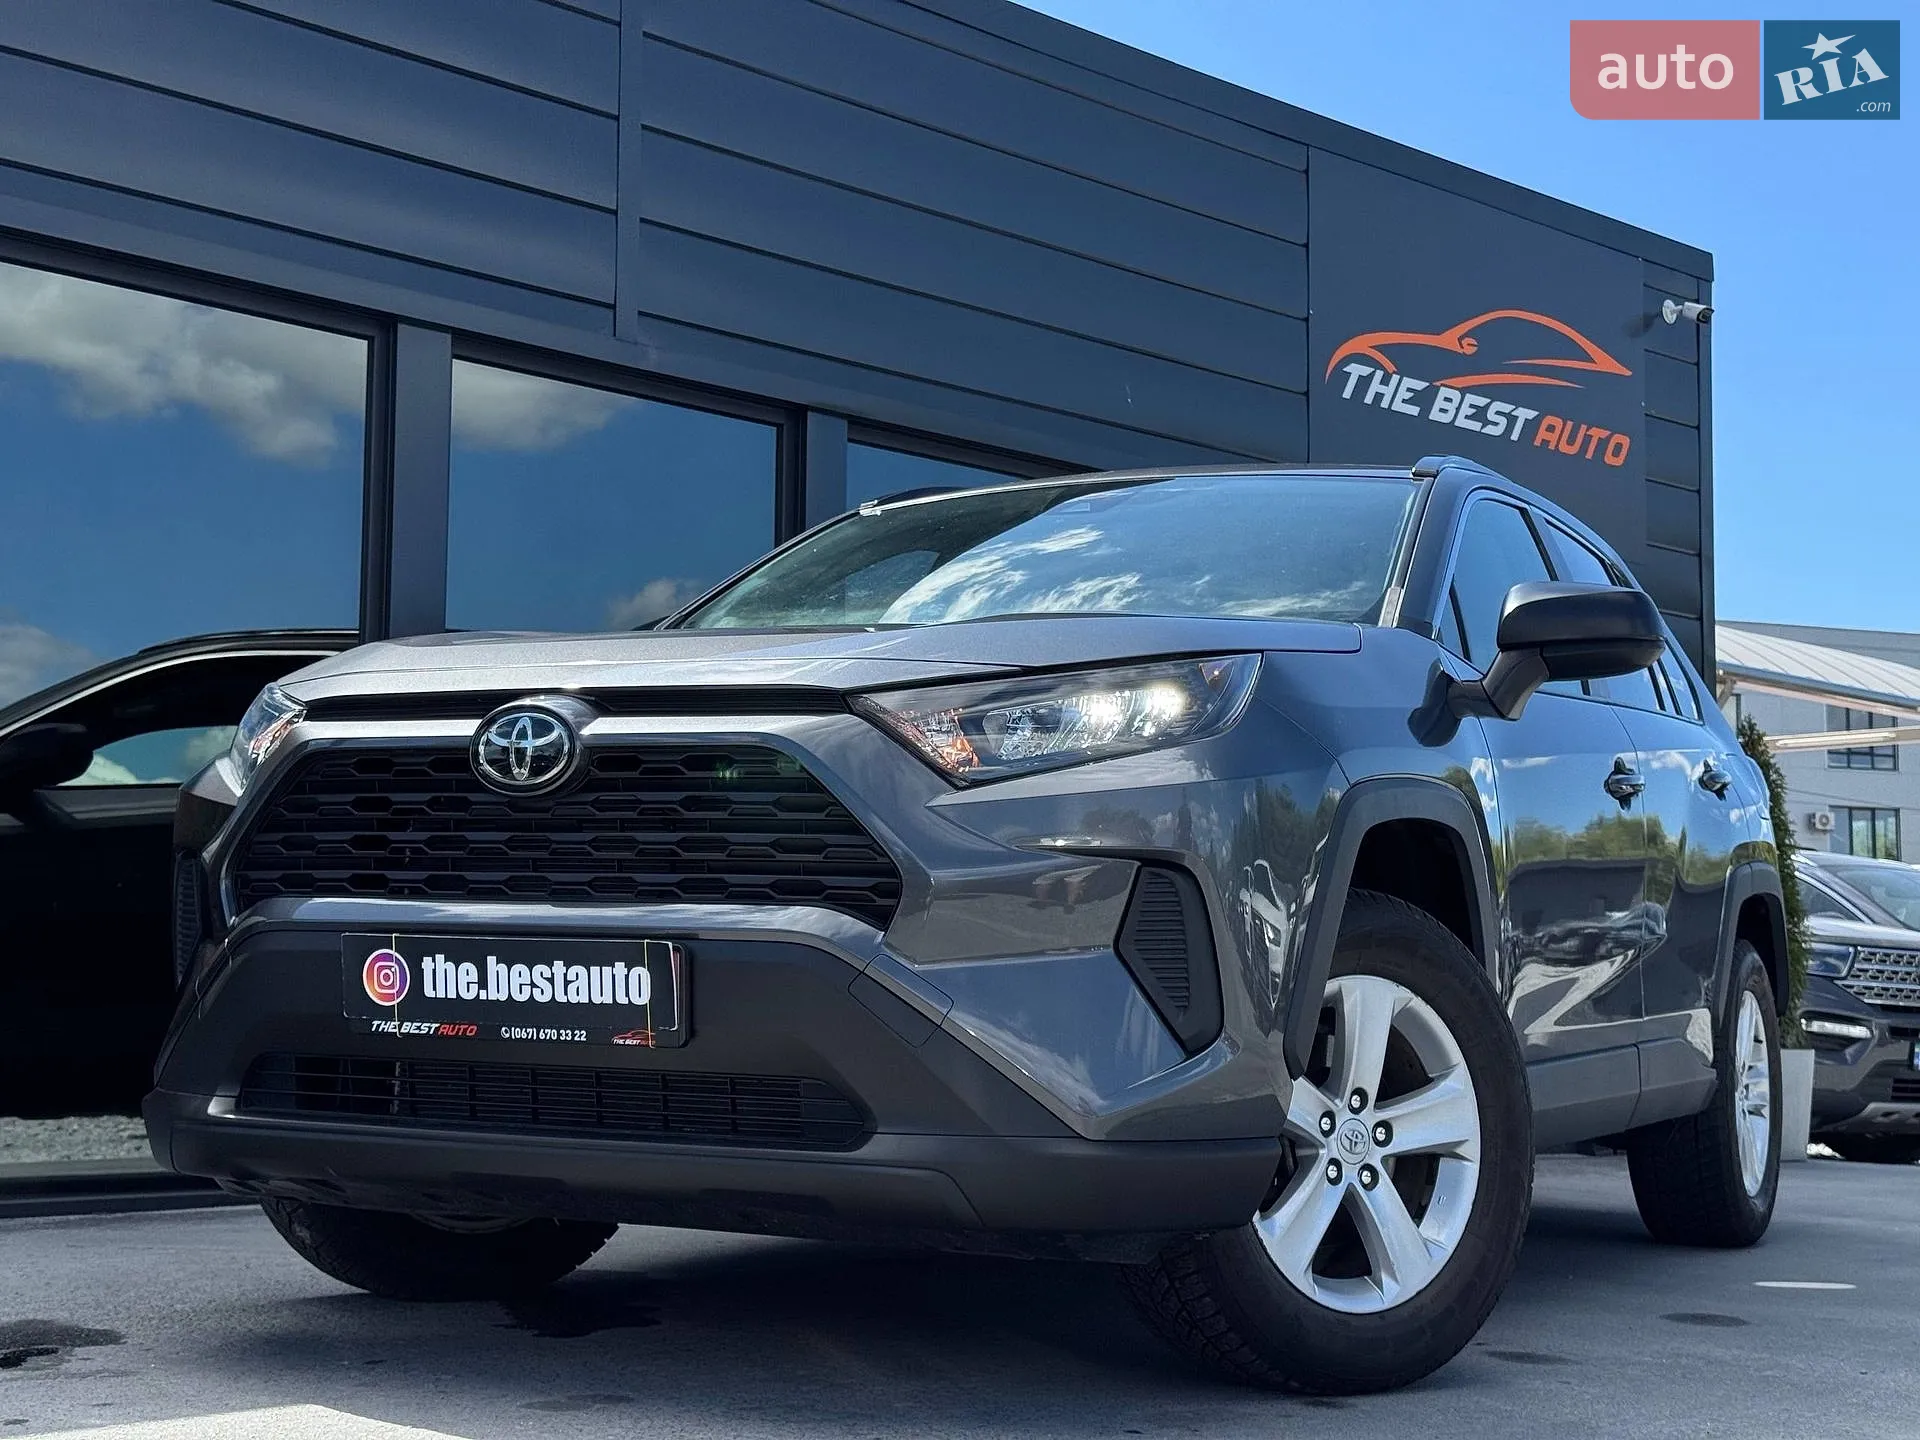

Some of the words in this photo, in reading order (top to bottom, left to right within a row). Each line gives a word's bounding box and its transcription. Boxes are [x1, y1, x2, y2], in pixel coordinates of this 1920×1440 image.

[1342, 363, 1430, 418] THE
[1429, 386, 1539, 442] BEST
[1533, 415, 1631, 467] AUTO
[421, 953, 651, 1006] the.bestauto
[371, 1020, 399, 1033] THE
[400, 1021, 440, 1035] BEST
[438, 1024, 478, 1036] AUTO
[511, 1026, 537, 1040] (067)
[539, 1028, 558, 1040] 670
[560, 1029, 572, 1041] 33
[574, 1030, 587, 1041] 22
